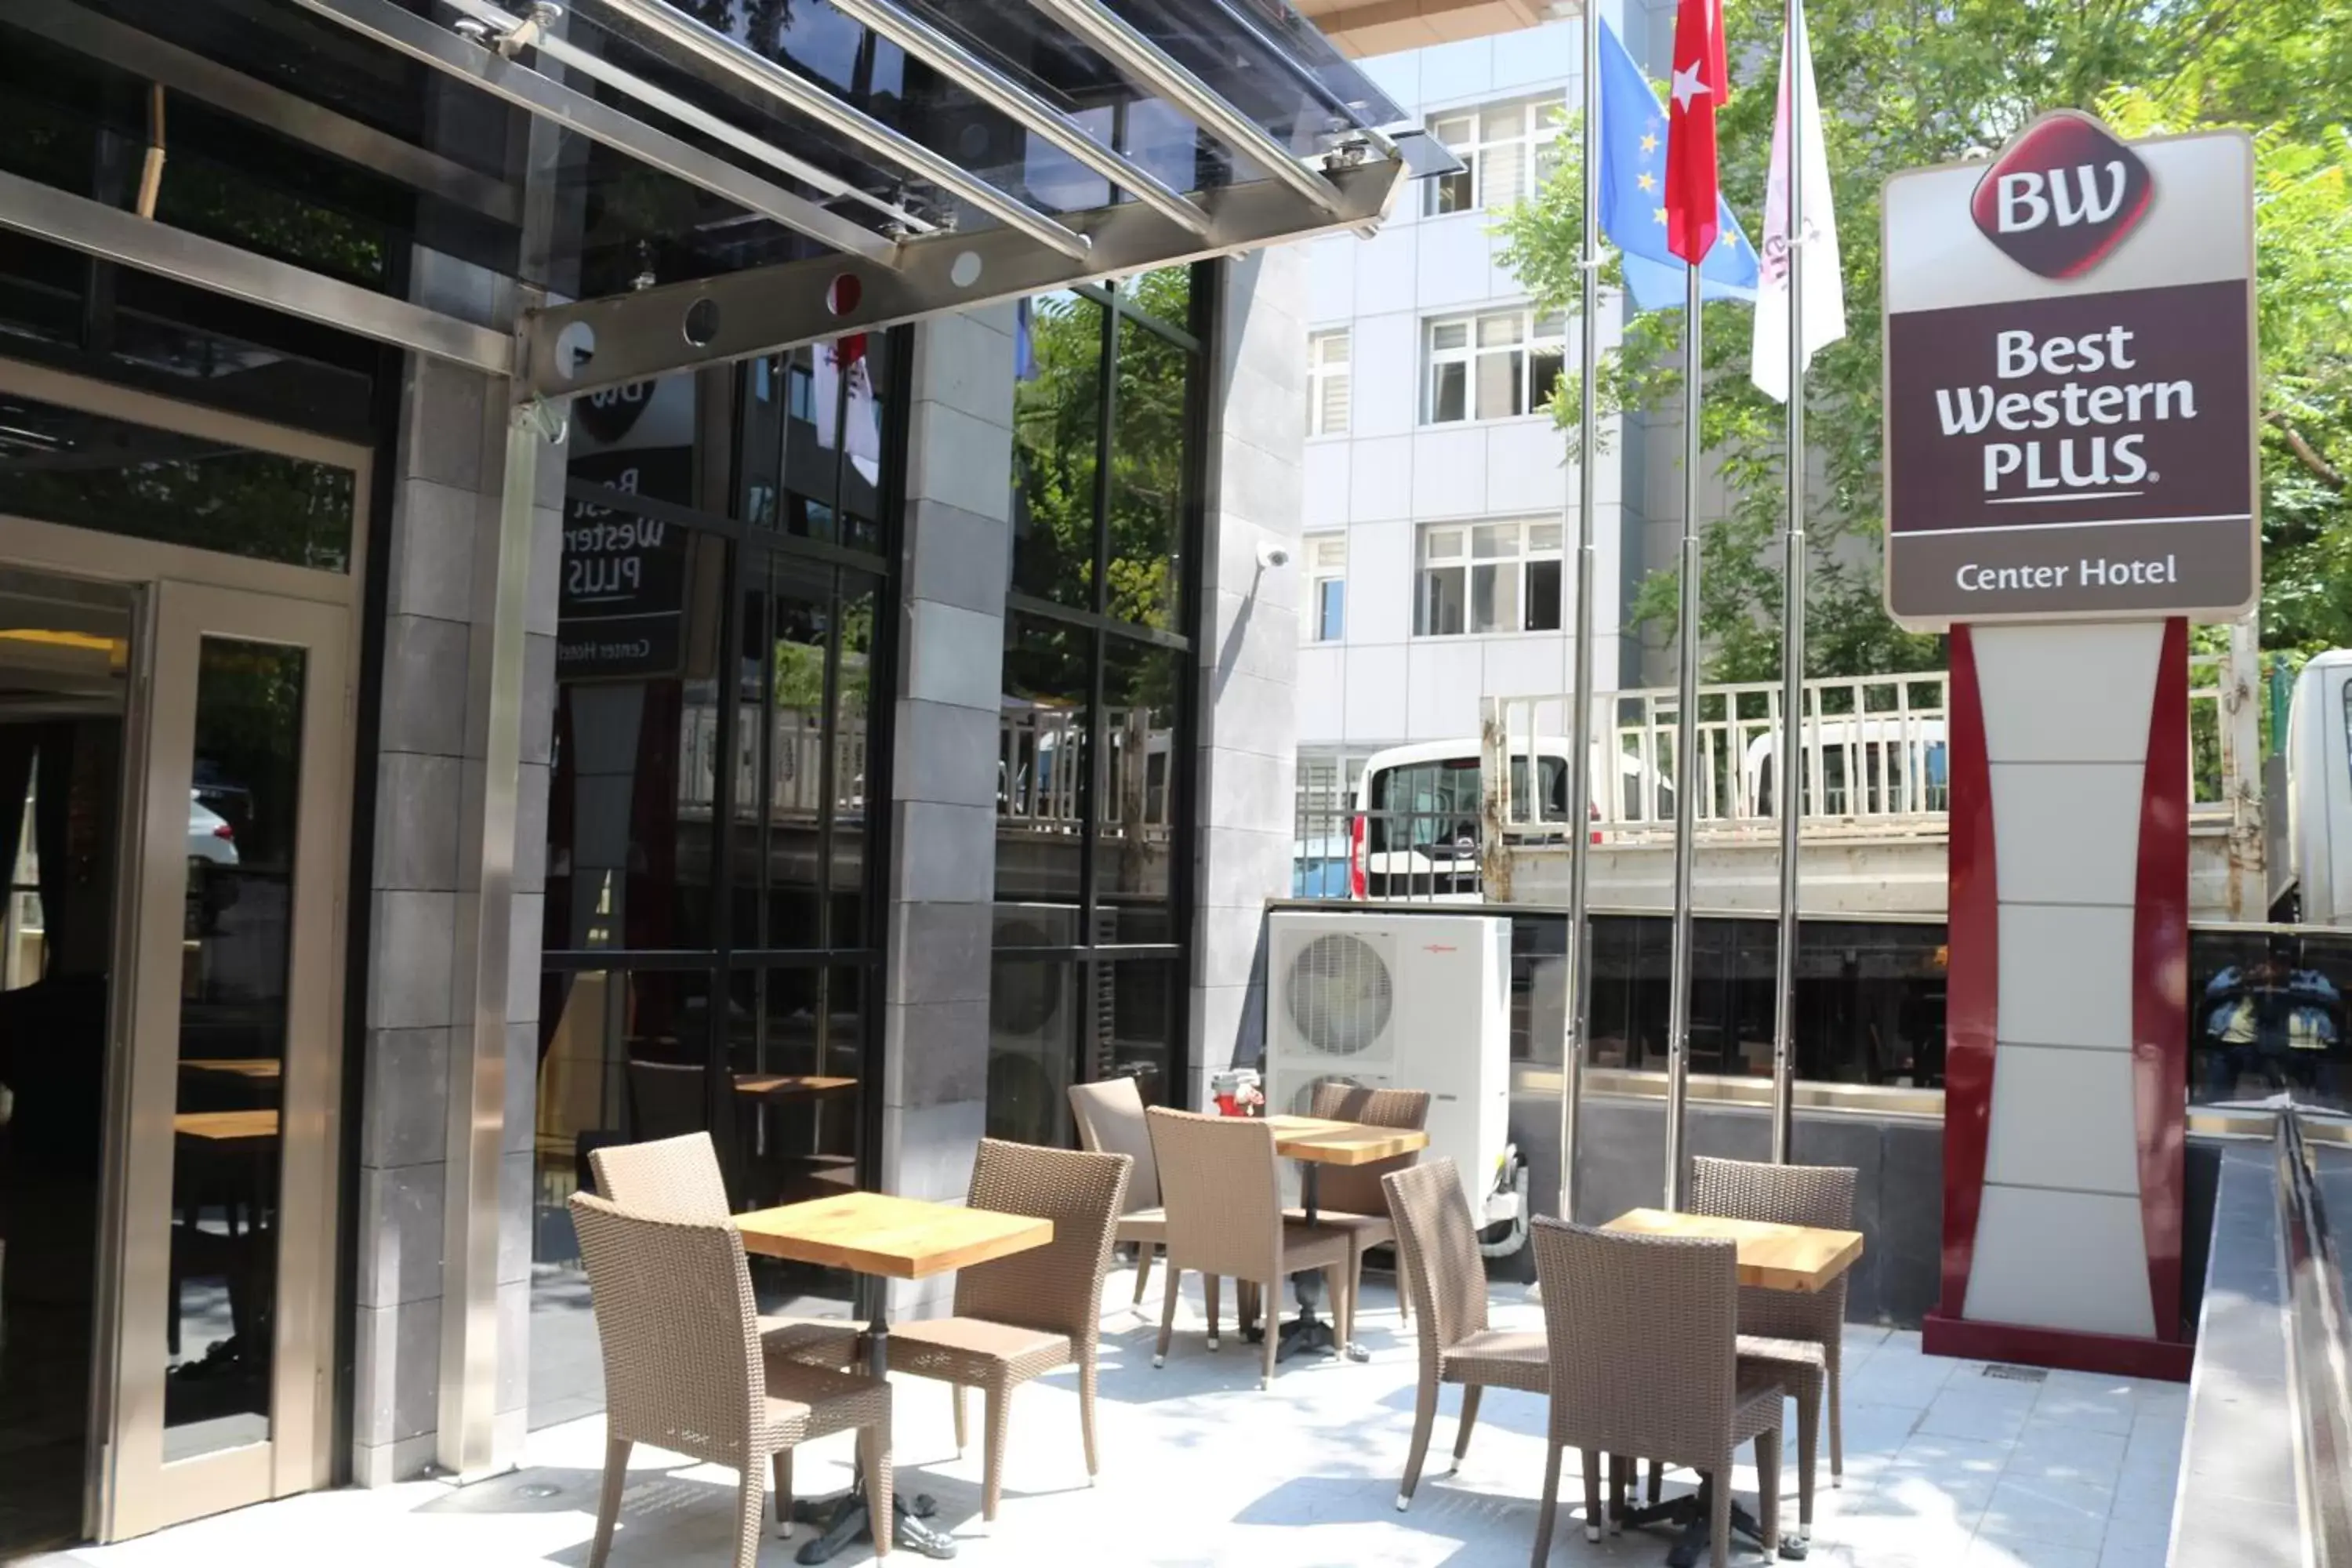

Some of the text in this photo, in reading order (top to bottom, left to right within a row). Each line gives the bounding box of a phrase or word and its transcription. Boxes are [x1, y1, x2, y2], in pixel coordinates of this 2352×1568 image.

[1997, 161, 2125, 234] BW
[1997, 325, 2136, 379] Best
[1936, 379, 2198, 437] Western
[1956, 554, 2177, 591] Center Hotel
